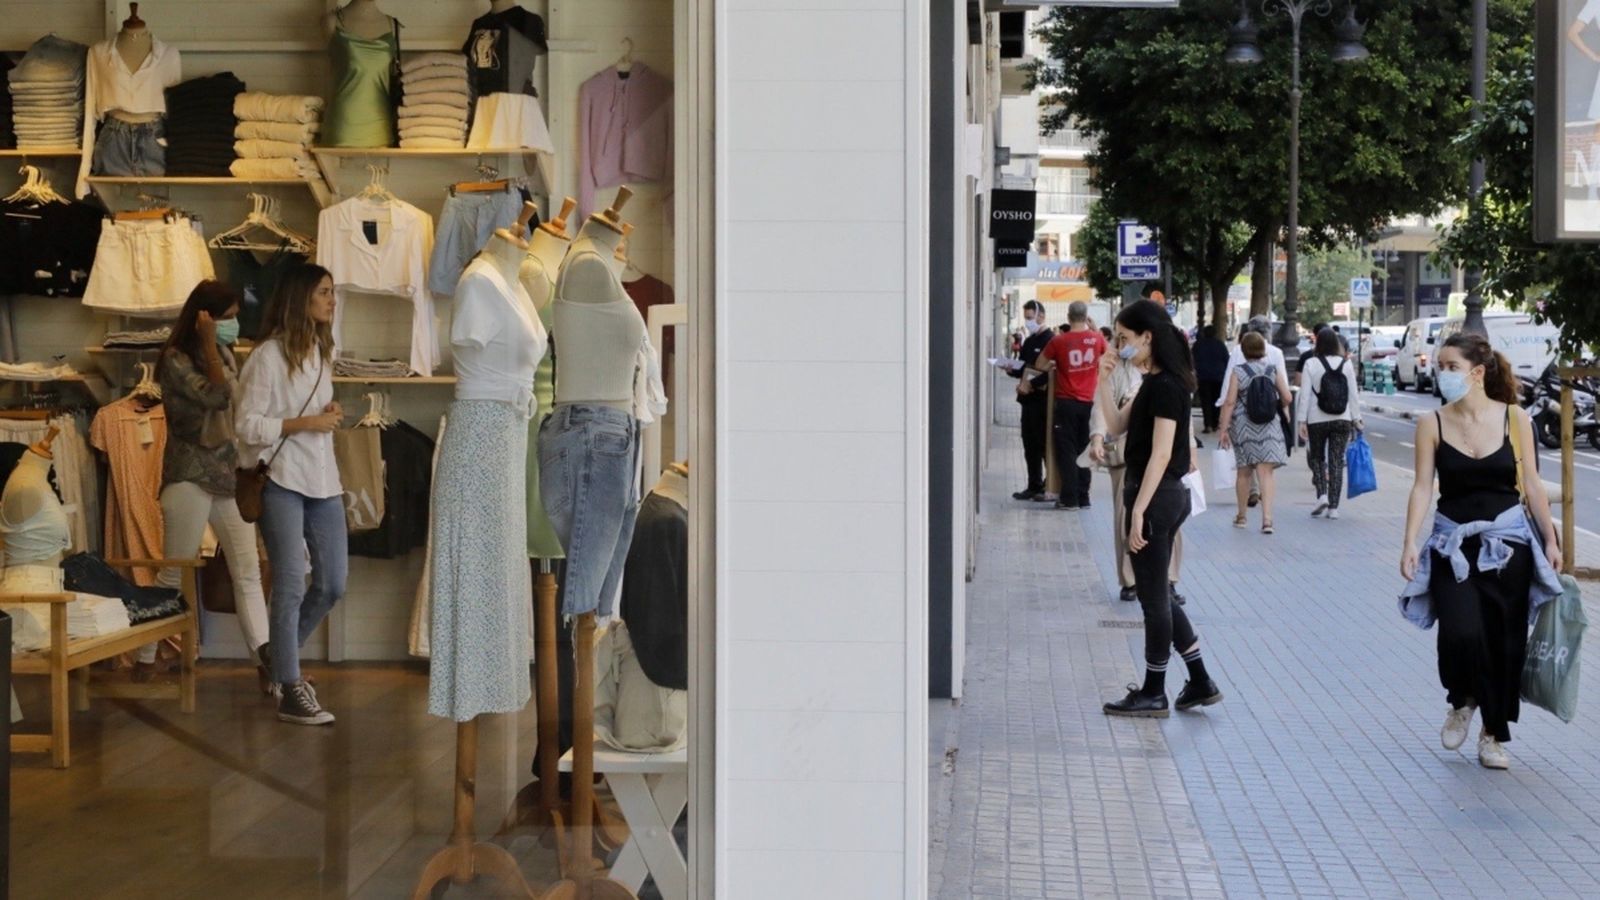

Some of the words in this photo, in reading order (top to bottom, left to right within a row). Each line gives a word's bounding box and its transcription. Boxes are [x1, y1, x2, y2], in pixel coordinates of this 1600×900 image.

[992, 209, 1033, 221] OYSHO
[1124, 225, 1153, 255] P
[998, 247, 1026, 255] OYSHO
[1069, 348, 1095, 367] 04
